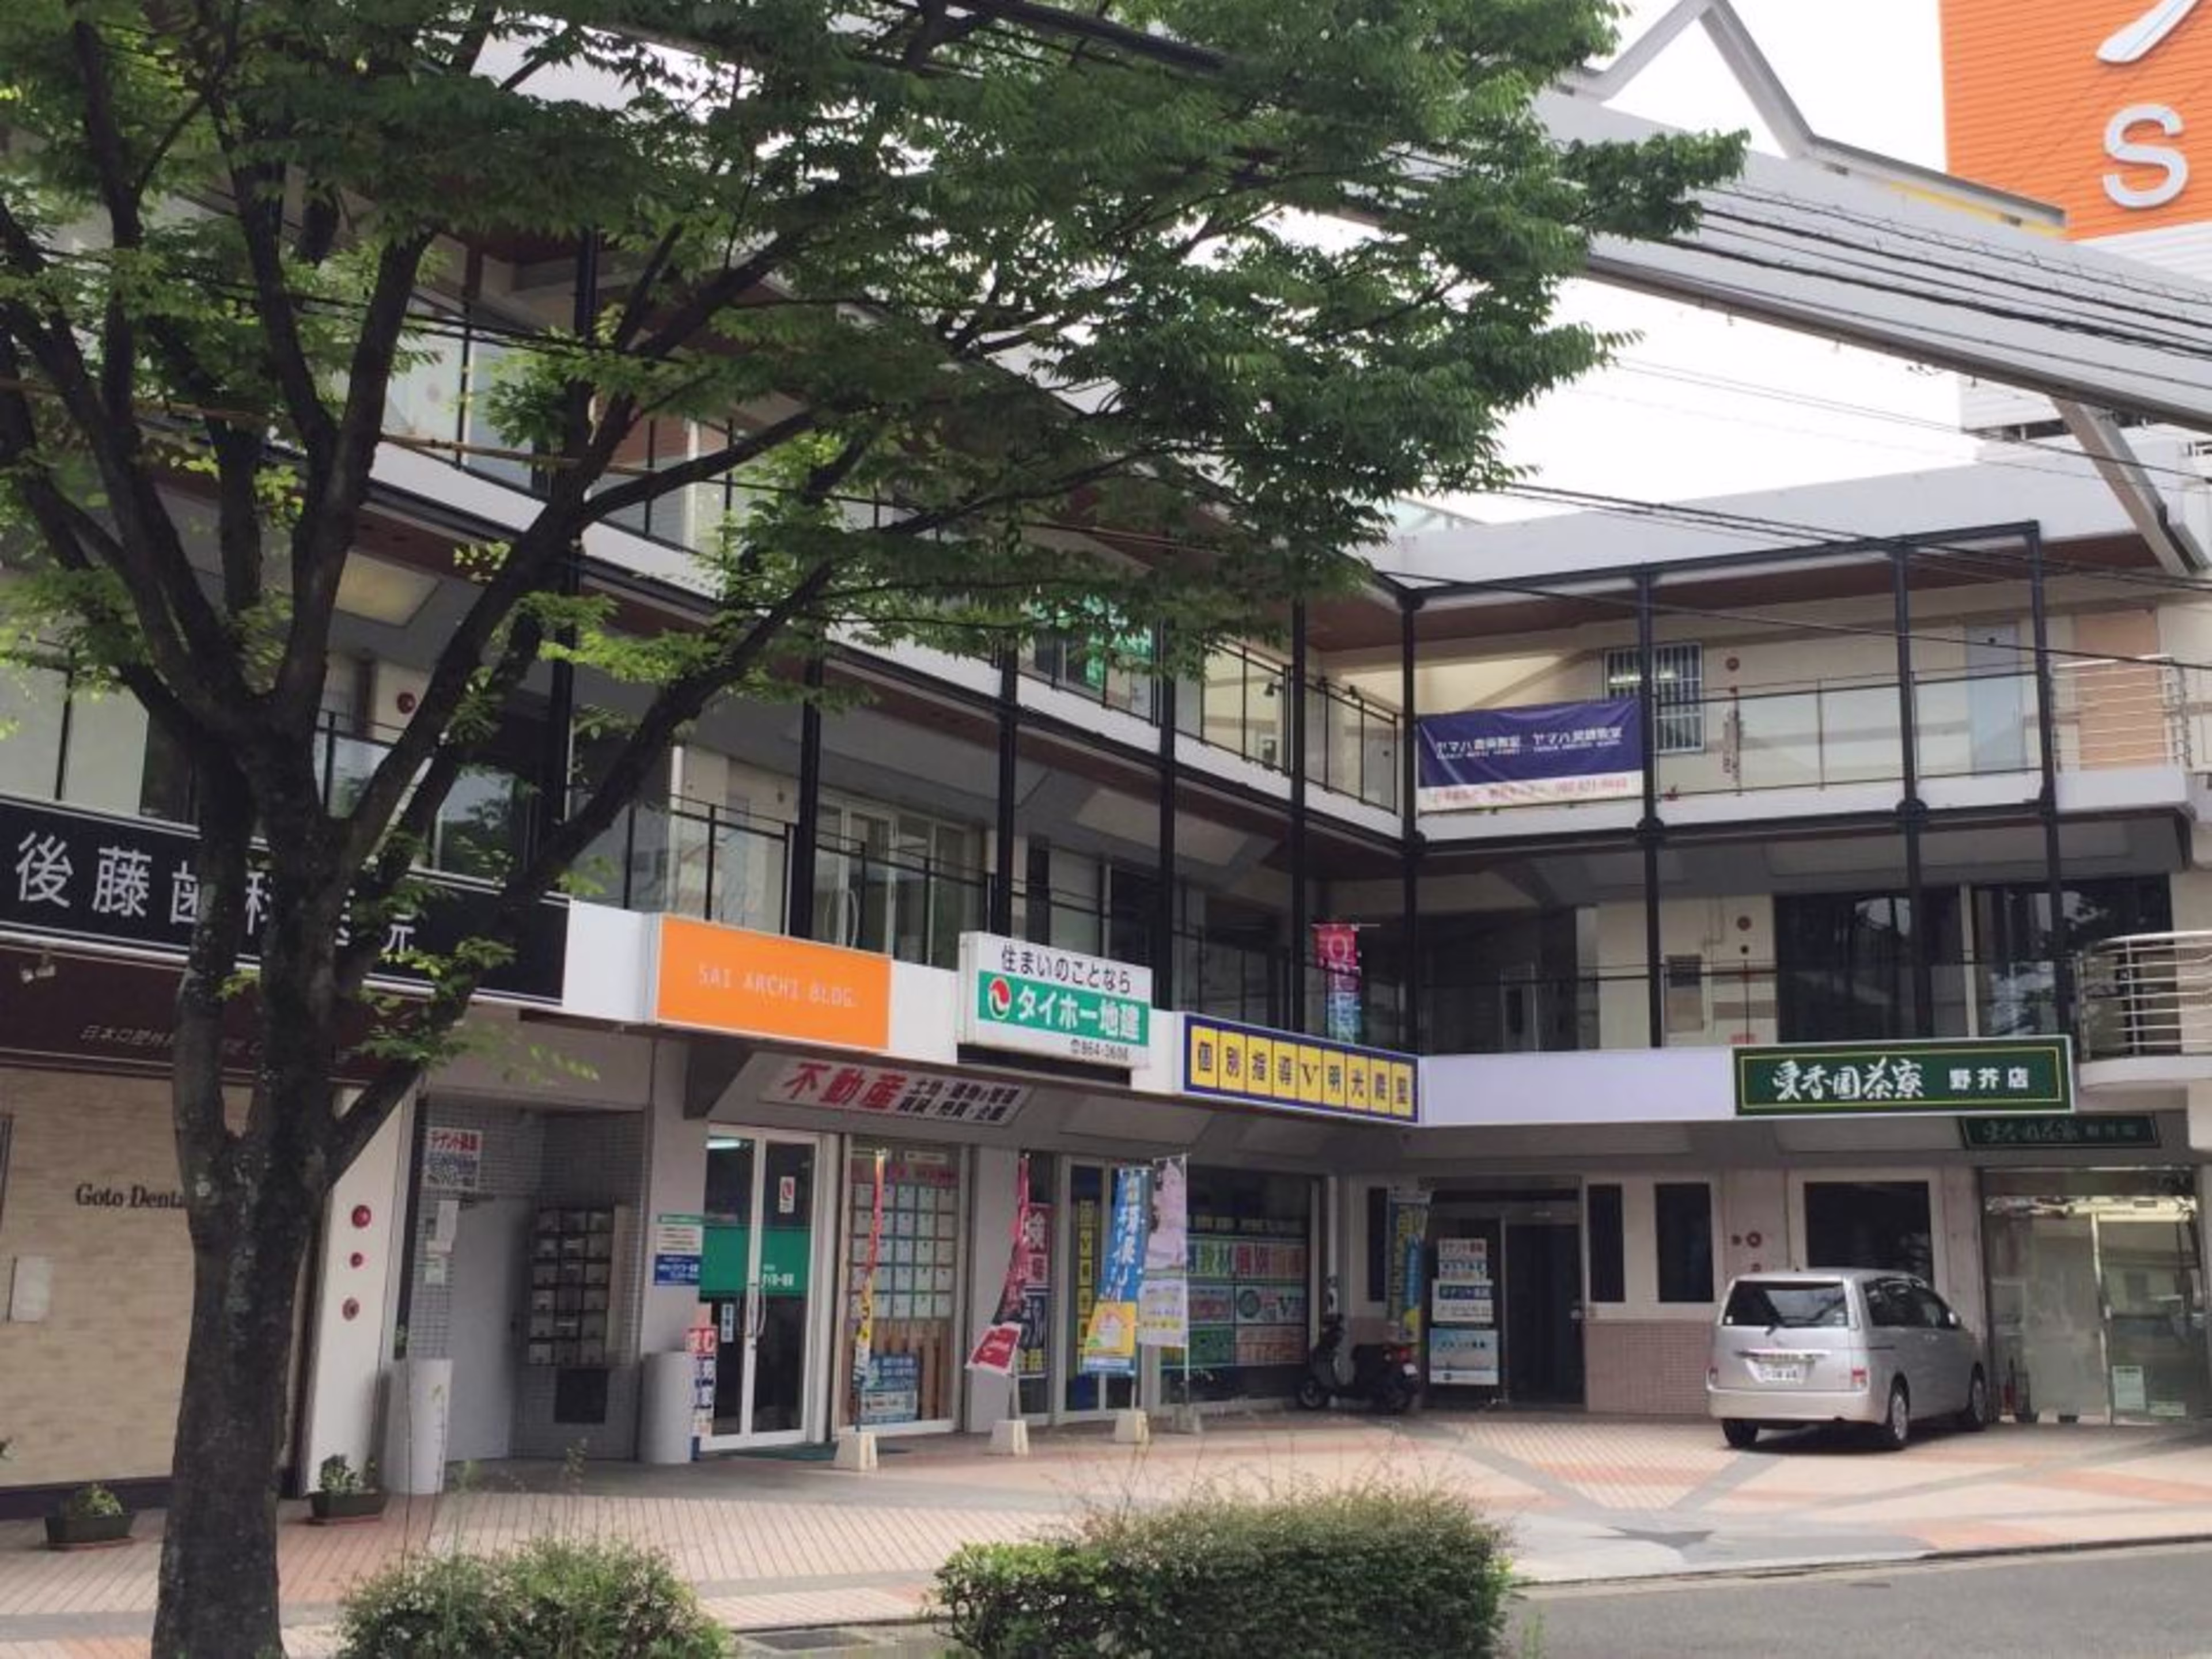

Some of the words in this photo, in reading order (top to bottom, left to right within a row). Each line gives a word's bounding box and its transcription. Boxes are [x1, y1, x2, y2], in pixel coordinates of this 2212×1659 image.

[1001, 944, 1131, 994] 住まいのことなら
[783, 1062, 908, 1111] 不動産
[75, 1183, 123, 1206] Goto
[131, 1185, 184, 1208] Dent
